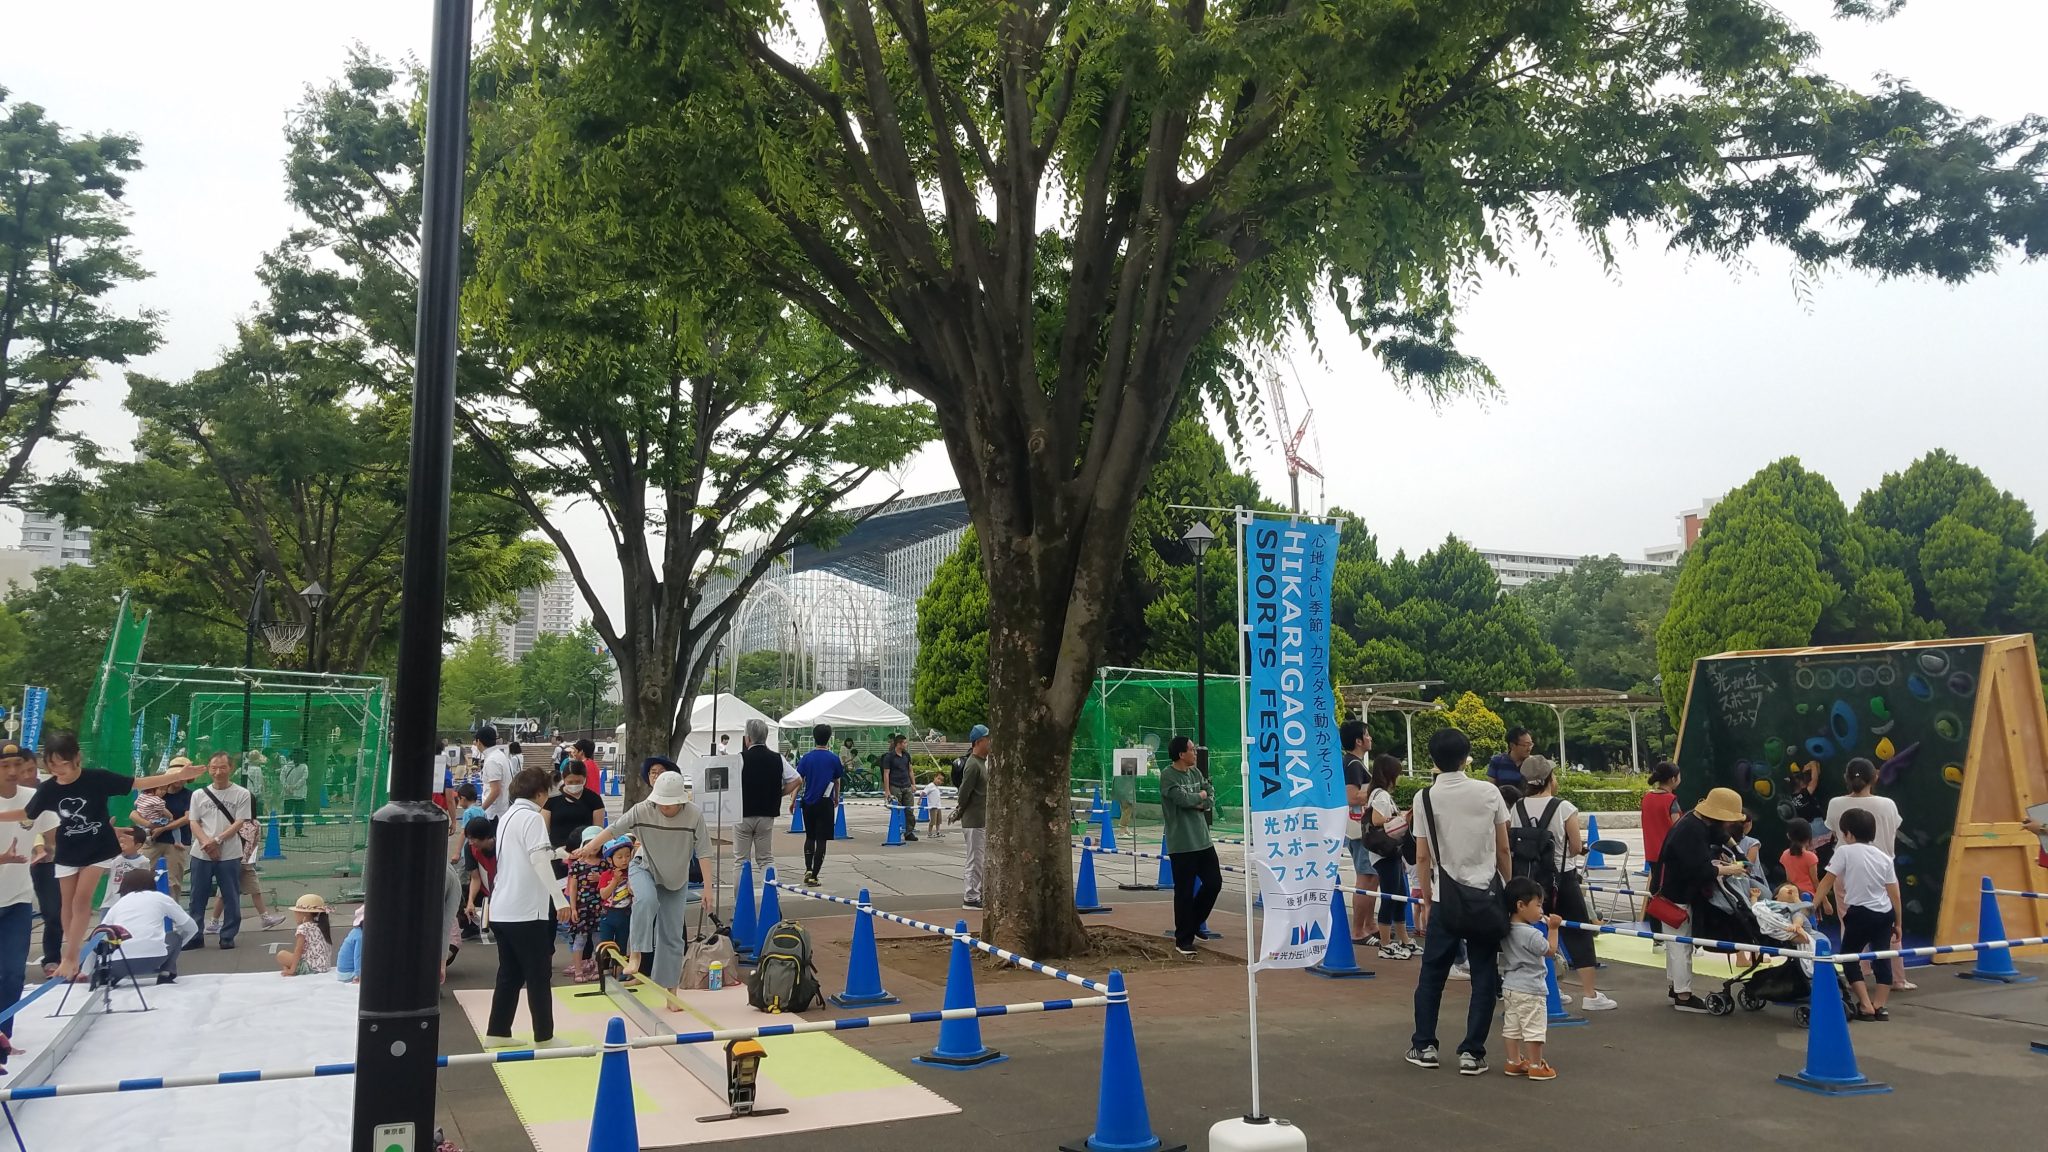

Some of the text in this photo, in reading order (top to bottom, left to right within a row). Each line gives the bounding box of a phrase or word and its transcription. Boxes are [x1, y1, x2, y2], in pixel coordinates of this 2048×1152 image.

[1256, 529, 1282, 798] SPORTS FESTA
[1281, 531, 1313, 797] HIKARIGAOKA
[1264, 812, 1318, 835] 光が丘
[1267, 837, 1340, 859] スポーツ
[1270, 861, 1340, 882] フェスタ
